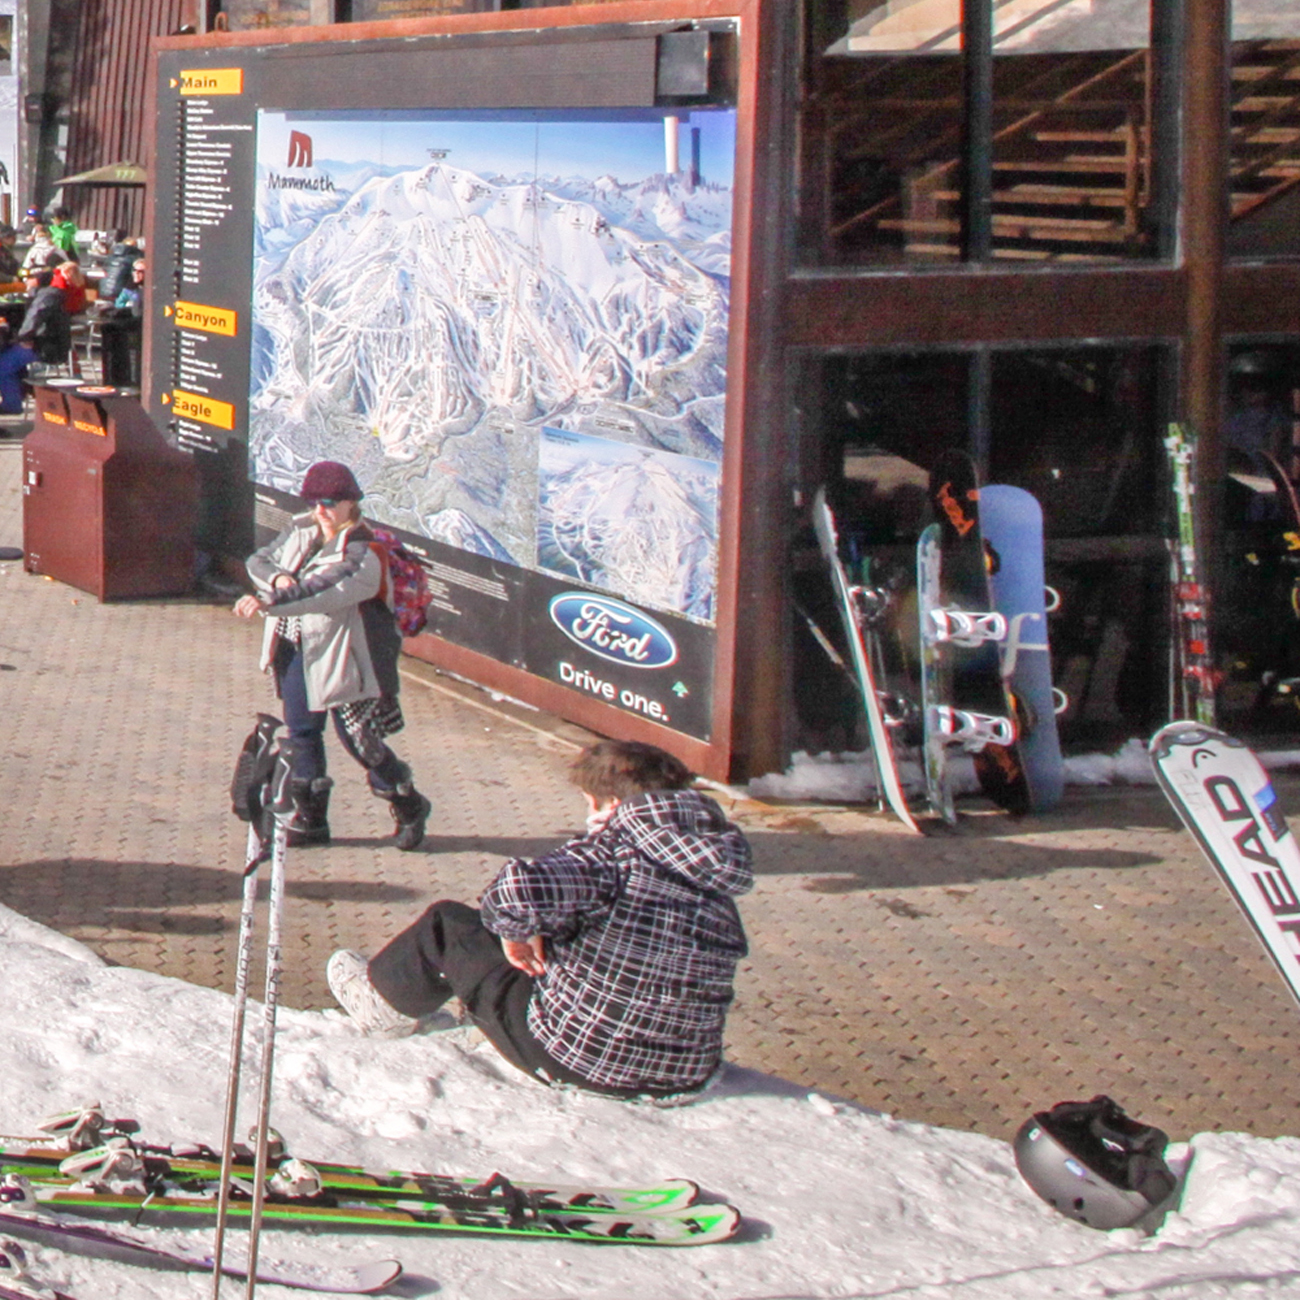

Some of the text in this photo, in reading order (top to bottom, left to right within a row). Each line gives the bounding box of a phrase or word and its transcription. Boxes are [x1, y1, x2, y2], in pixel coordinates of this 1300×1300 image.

[180, 76, 218, 88] Main
[268, 172, 337, 193] Mammoth
[175, 307, 227, 327] Canyon
[174, 397, 211, 417] Eagle
[572, 602, 650, 662] Ford
[559, 661, 670, 722] Drive one.
